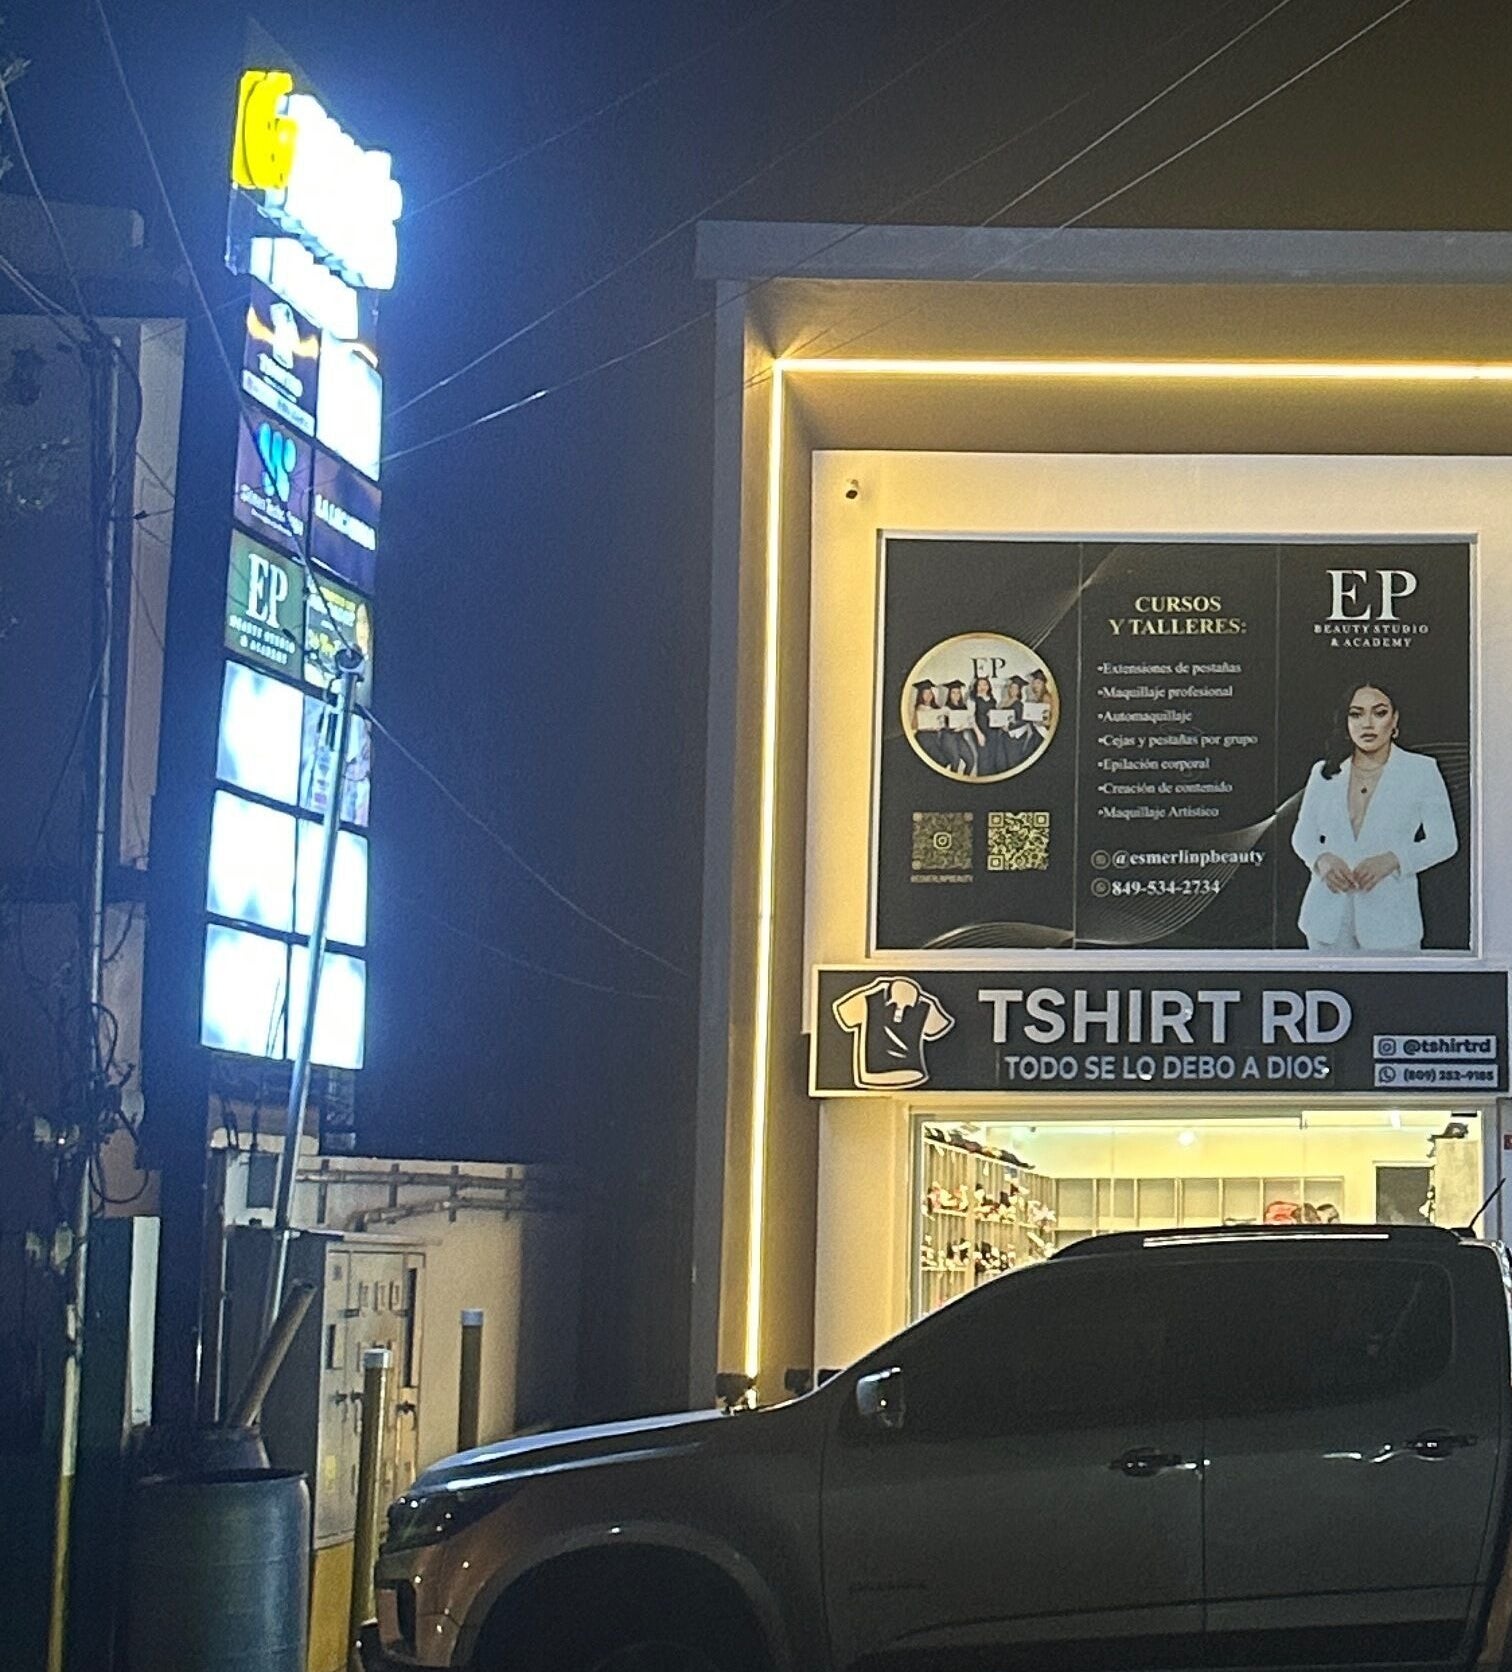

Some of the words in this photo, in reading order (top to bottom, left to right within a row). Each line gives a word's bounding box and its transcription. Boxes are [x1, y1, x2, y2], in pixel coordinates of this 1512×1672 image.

[245, 553, 288, 628] EP
[1326, 569, 1418, 620] EP
[1135, 596, 1222, 612] CURSOS
[1108, 619, 1125, 635] Y
[1128, 618, 1247, 635] TALLERES:
[1313, 624, 1370, 634] BEAUTY
[1373, 624, 1429, 634] STUDIO
[1343, 638, 1412, 647] ACADEMY
[1175, 662, 1190, 674] de
[1168, 686, 1233, 700] profesional
[1138, 737, 1148, 748] y
[1201, 736, 1221, 748] por
[1223, 736, 1258, 748] grupo
[1161, 757, 1210, 771] corporal
[1158, 782, 1172, 794] de
[1175, 781, 1233, 793] contenido
[1111, 879, 1220, 896] 849-534-2734
[978, 988, 1241, 1045] TSHIRT
[1262, 990, 1352, 1044] RD
[1403, 1038, 1491, 1055] @tshirtrd
[1004, 1056, 1078, 1080] TODO
[1085, 1056, 1116, 1080] SE
[1123, 1056, 1156, 1081] LO
[1163, 1056, 1235, 1080] DEBO
[1241, 1056, 1261, 1080] A
[1267, 1056, 1330, 1080] DIOS
